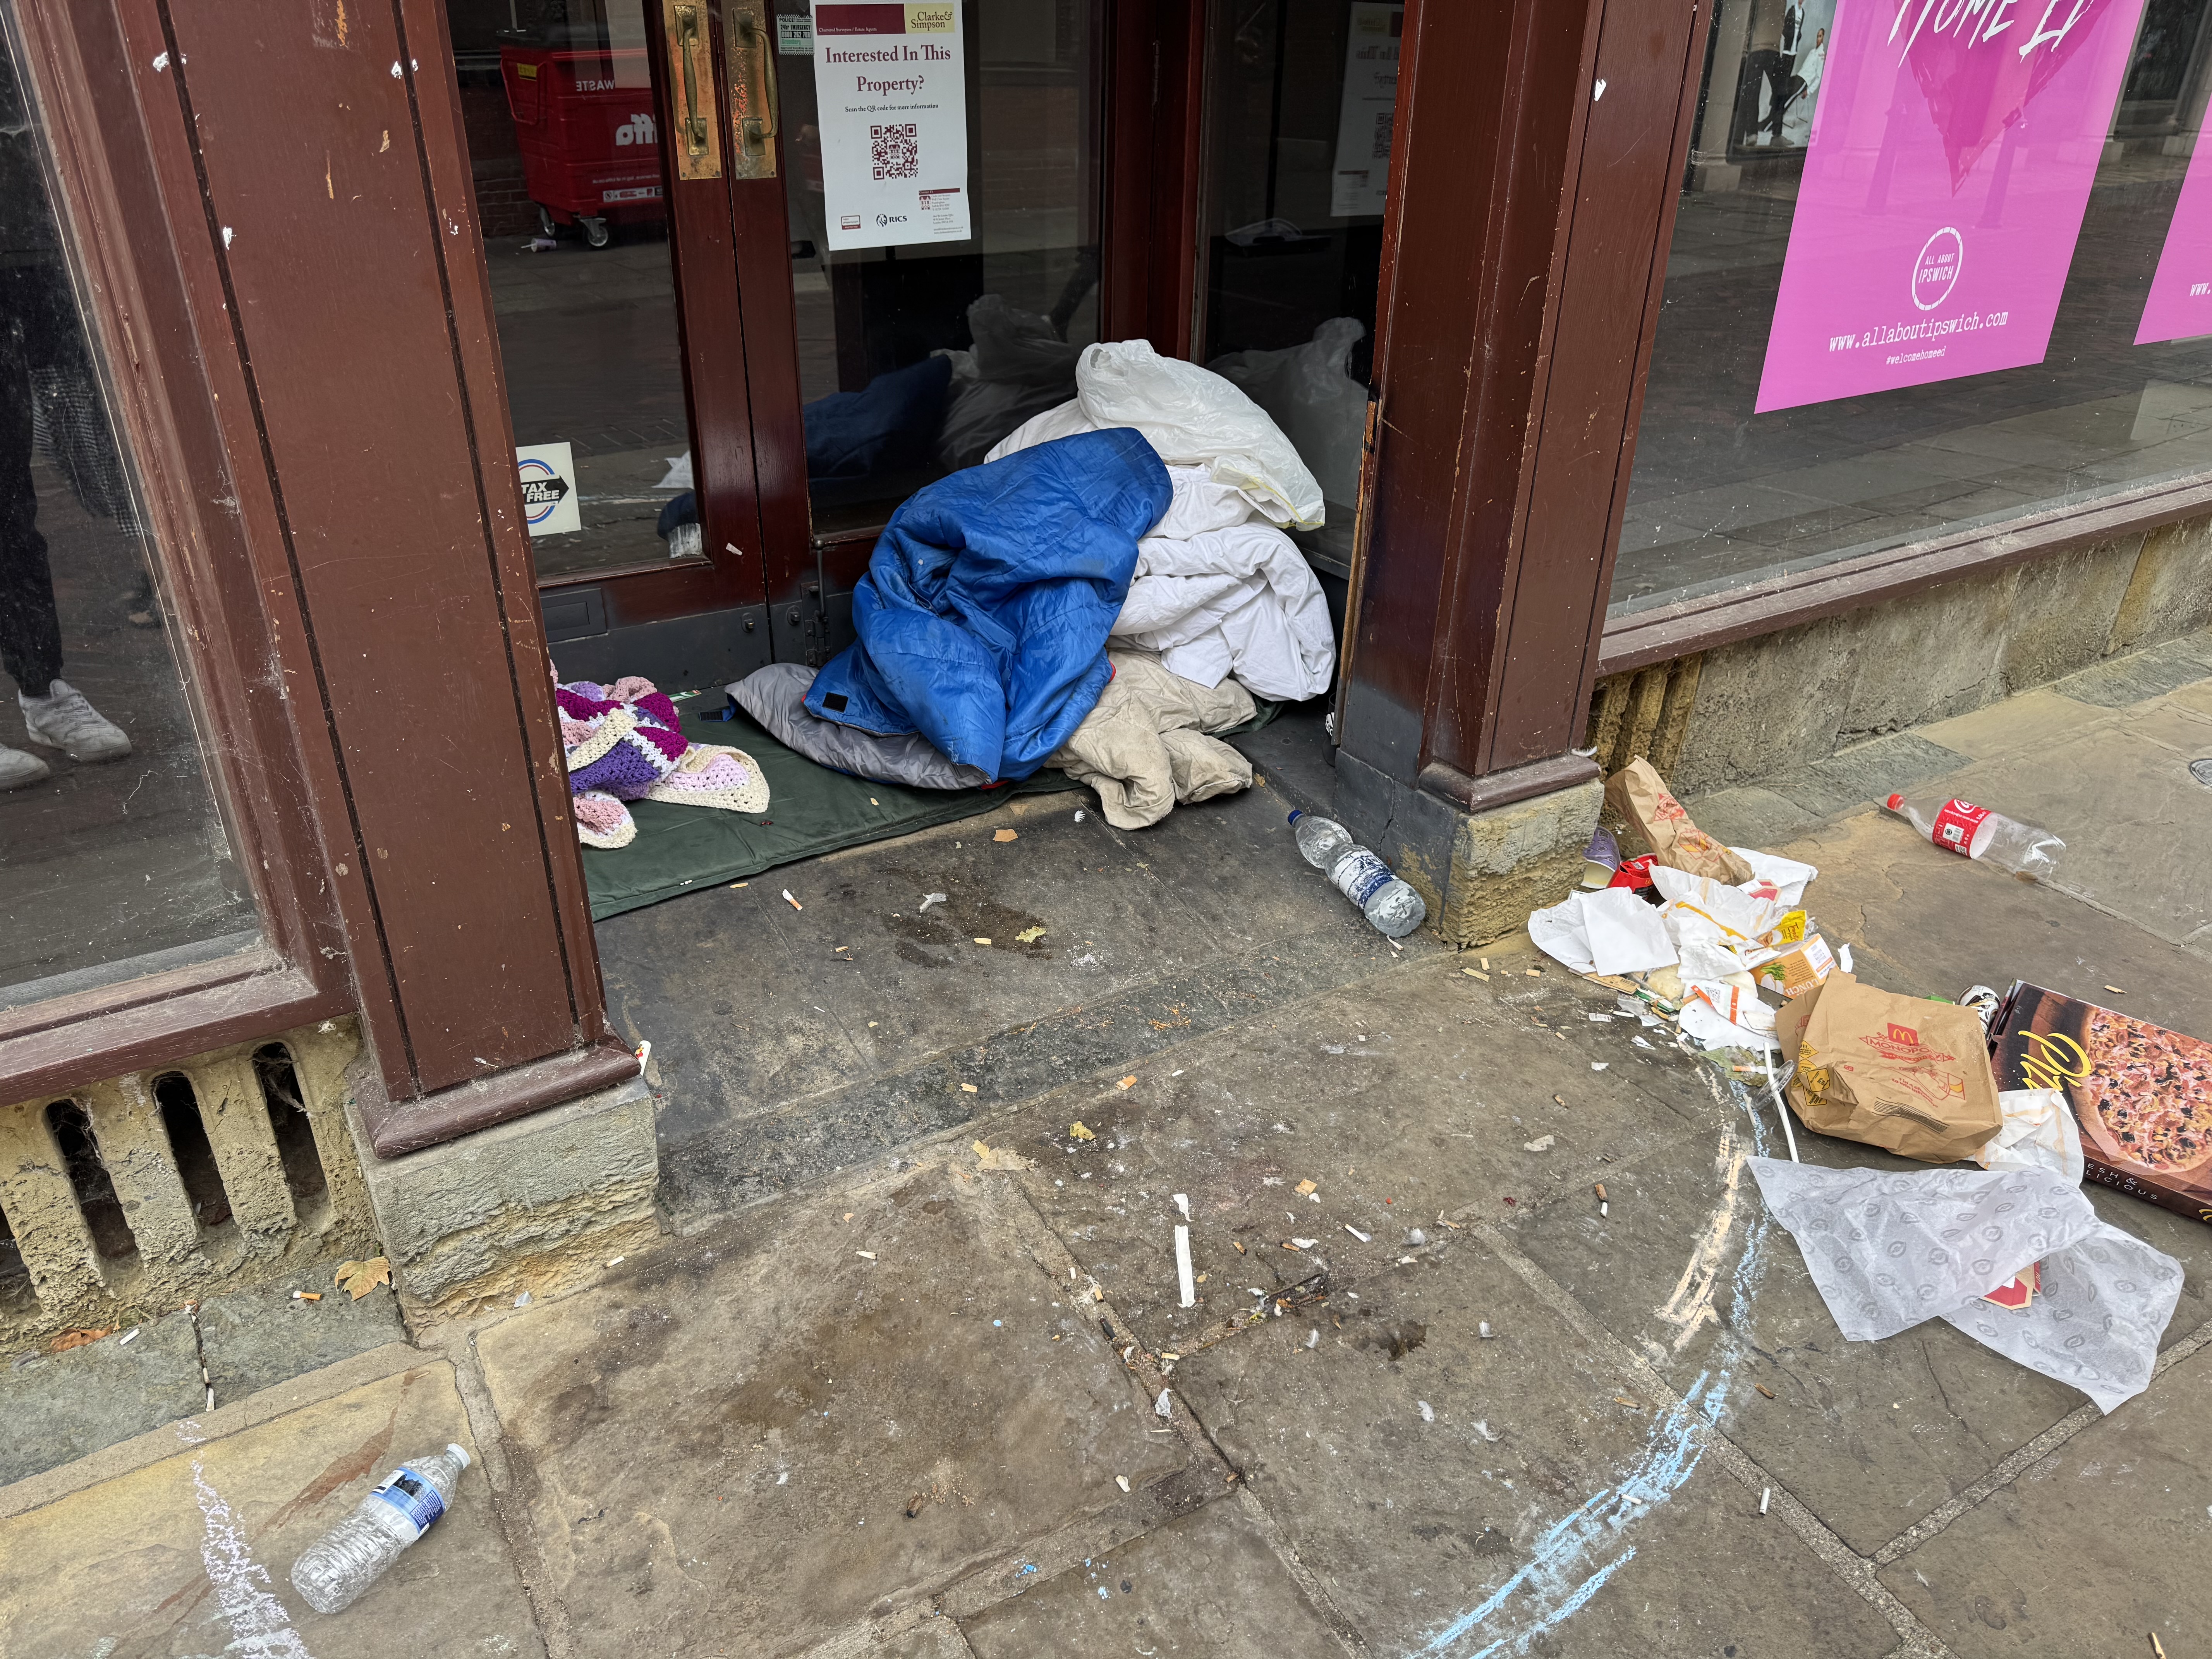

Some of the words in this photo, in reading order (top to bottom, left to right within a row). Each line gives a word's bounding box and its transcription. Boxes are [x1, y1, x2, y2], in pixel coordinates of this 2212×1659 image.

[911, 19, 945, 31] Simpson
[825, 45, 899, 63] Interested
[902, 45, 919, 61] In
[921, 44, 951, 60] This
[856, 75, 924, 96] Property?
[1925, 255, 1934, 265] ALL
[1937, 253, 1955, 264] ABOUT
[1918, 265, 1954, 283] IPSWICH
[2190, 282, 2212, 297] www.
[1829, 311, 2008, 352] www.allaboutipswich.com
[1886, 346, 1946, 365] #welcomehomeed
[521, 482, 547, 494] TAX
[527, 489, 559, 502] FREE
[1786, 978, 1820, 996] LUNCH
[2126, 1178, 2138, 1186] &
